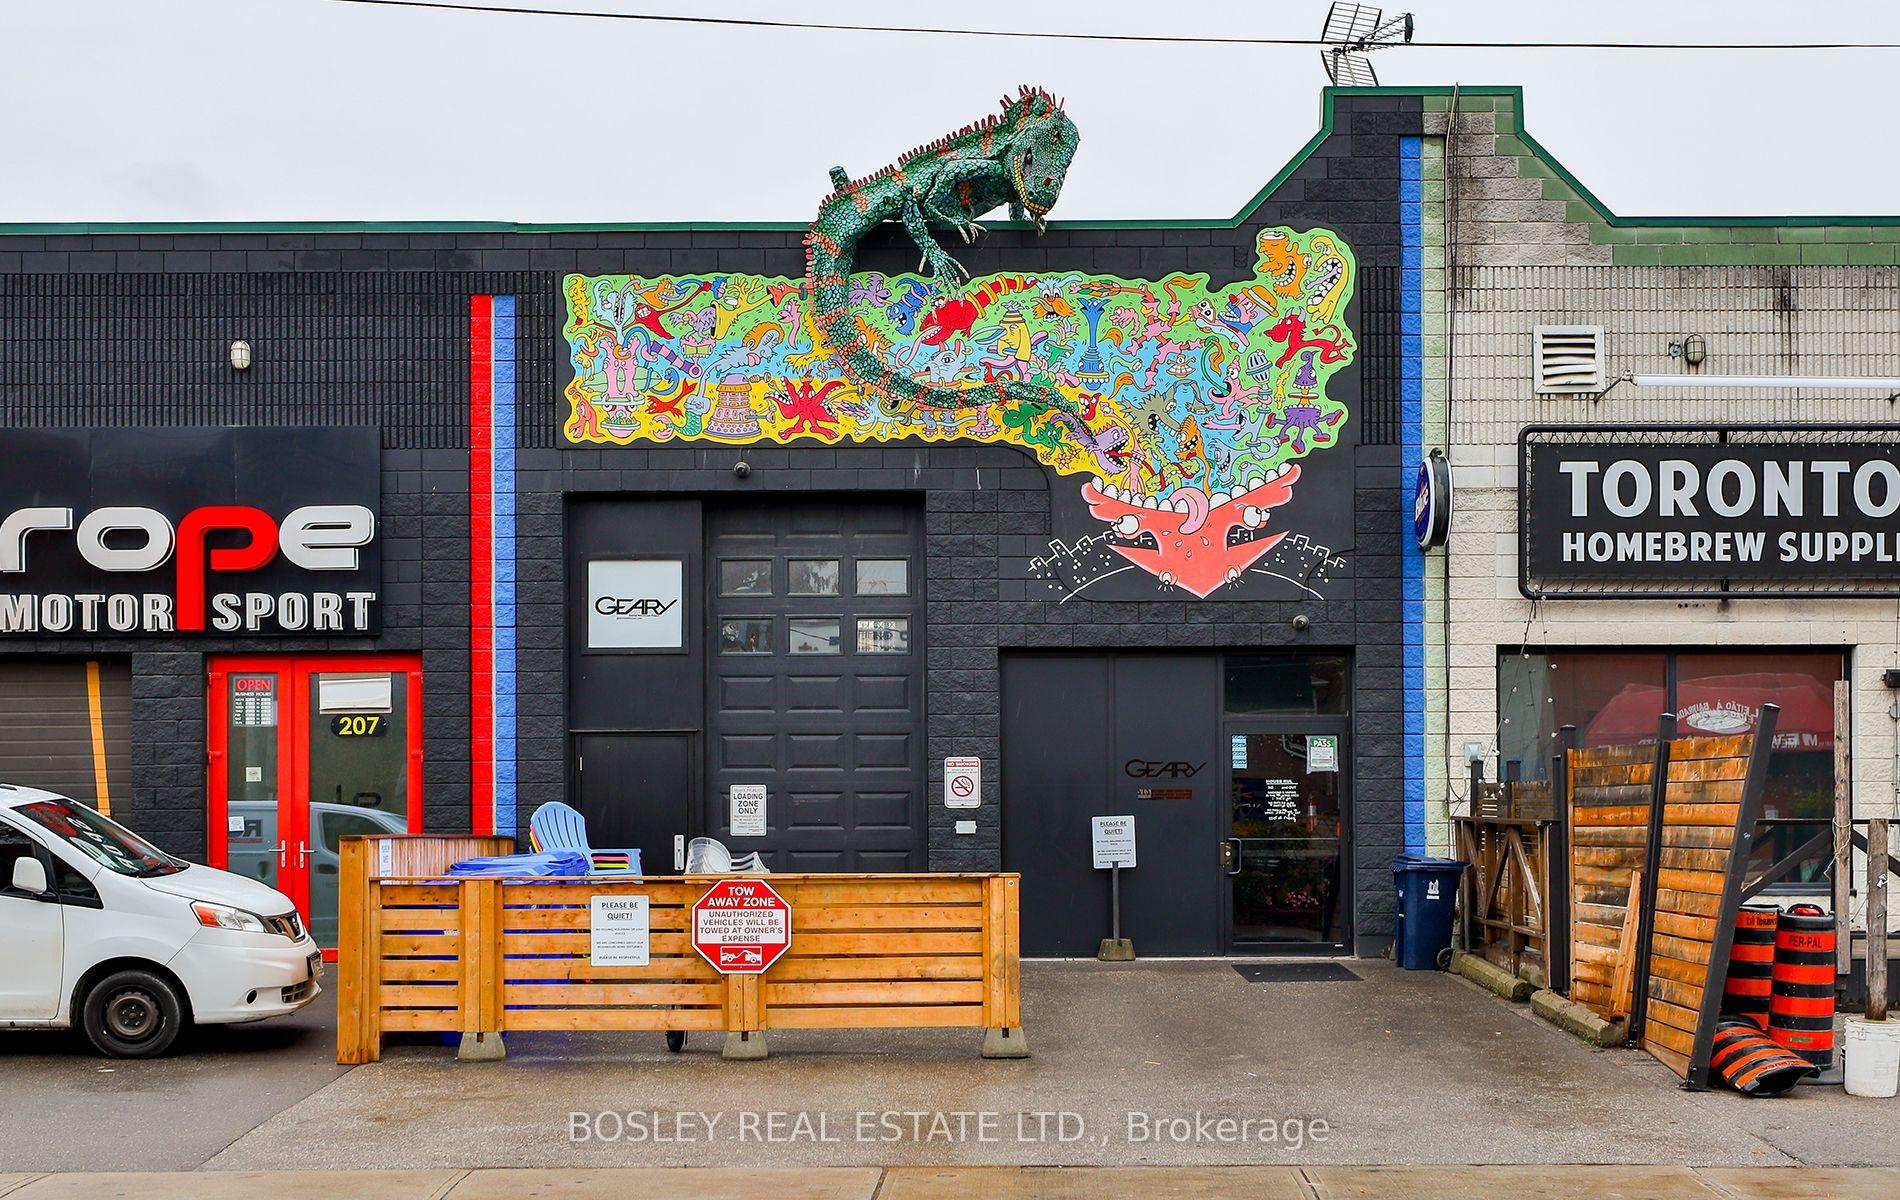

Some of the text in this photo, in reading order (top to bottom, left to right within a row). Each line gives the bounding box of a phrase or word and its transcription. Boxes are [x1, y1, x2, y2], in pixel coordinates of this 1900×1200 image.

[1559, 460, 1900, 517] TORONTO
[1562, 532, 1900, 562] HOMEBREW SUPPL
[0, 505, 375, 632] rope
[0, 592, 376, 632] MOTOR SPORT
[594, 596, 678, 616] GEARY
[236, 679, 271, 691] OPEN
[339, 716, 380, 735] 207
[1124, 759, 1208, 778] GEARY
[728, 886, 755, 897] TOW
[707, 897, 776, 907] AWAY ZONE
[607, 912, 633, 921] QUIET!
[1788, 935, 1823, 948] FER-PAL
